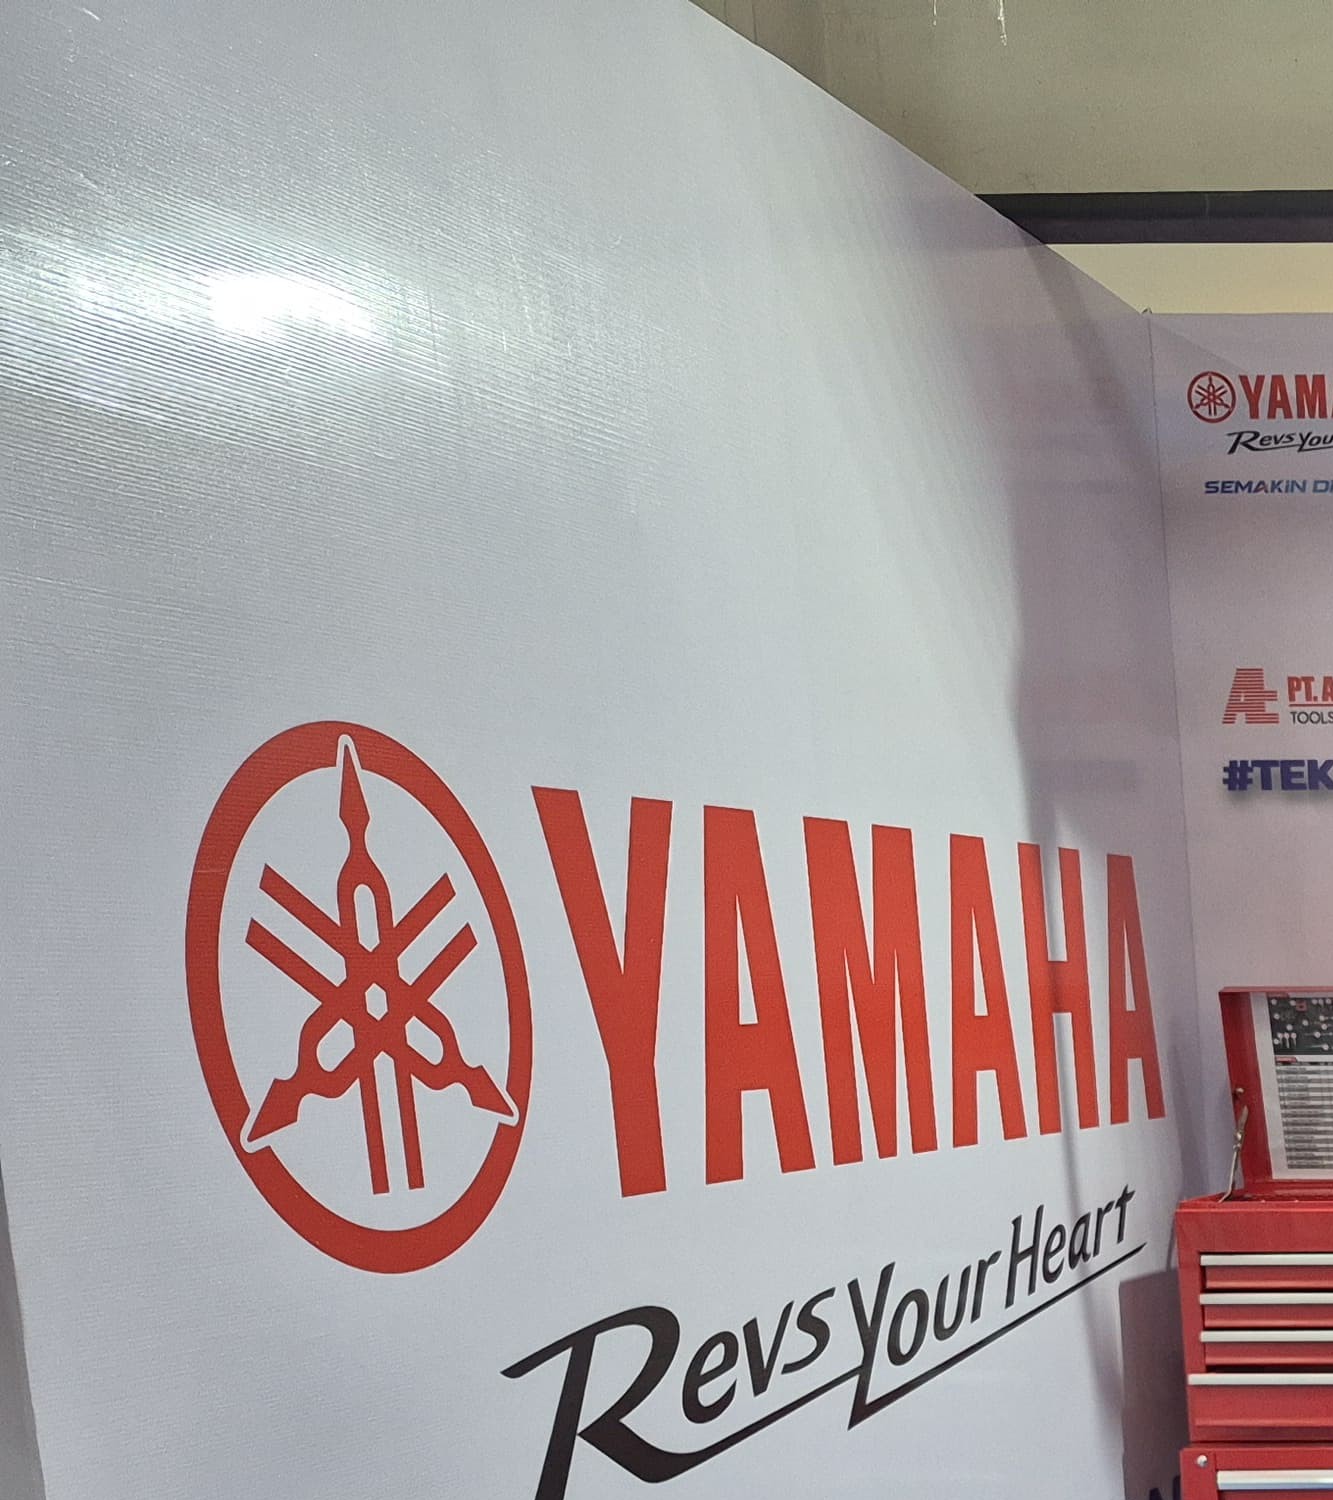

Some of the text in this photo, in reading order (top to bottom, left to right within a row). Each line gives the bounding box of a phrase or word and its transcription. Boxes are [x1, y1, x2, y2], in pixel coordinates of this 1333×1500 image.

[1227, 430, 1296, 456] Revs
[1287, 676, 1318, 702] PT.
[532, 786, 1166, 1197] YAMAHA
